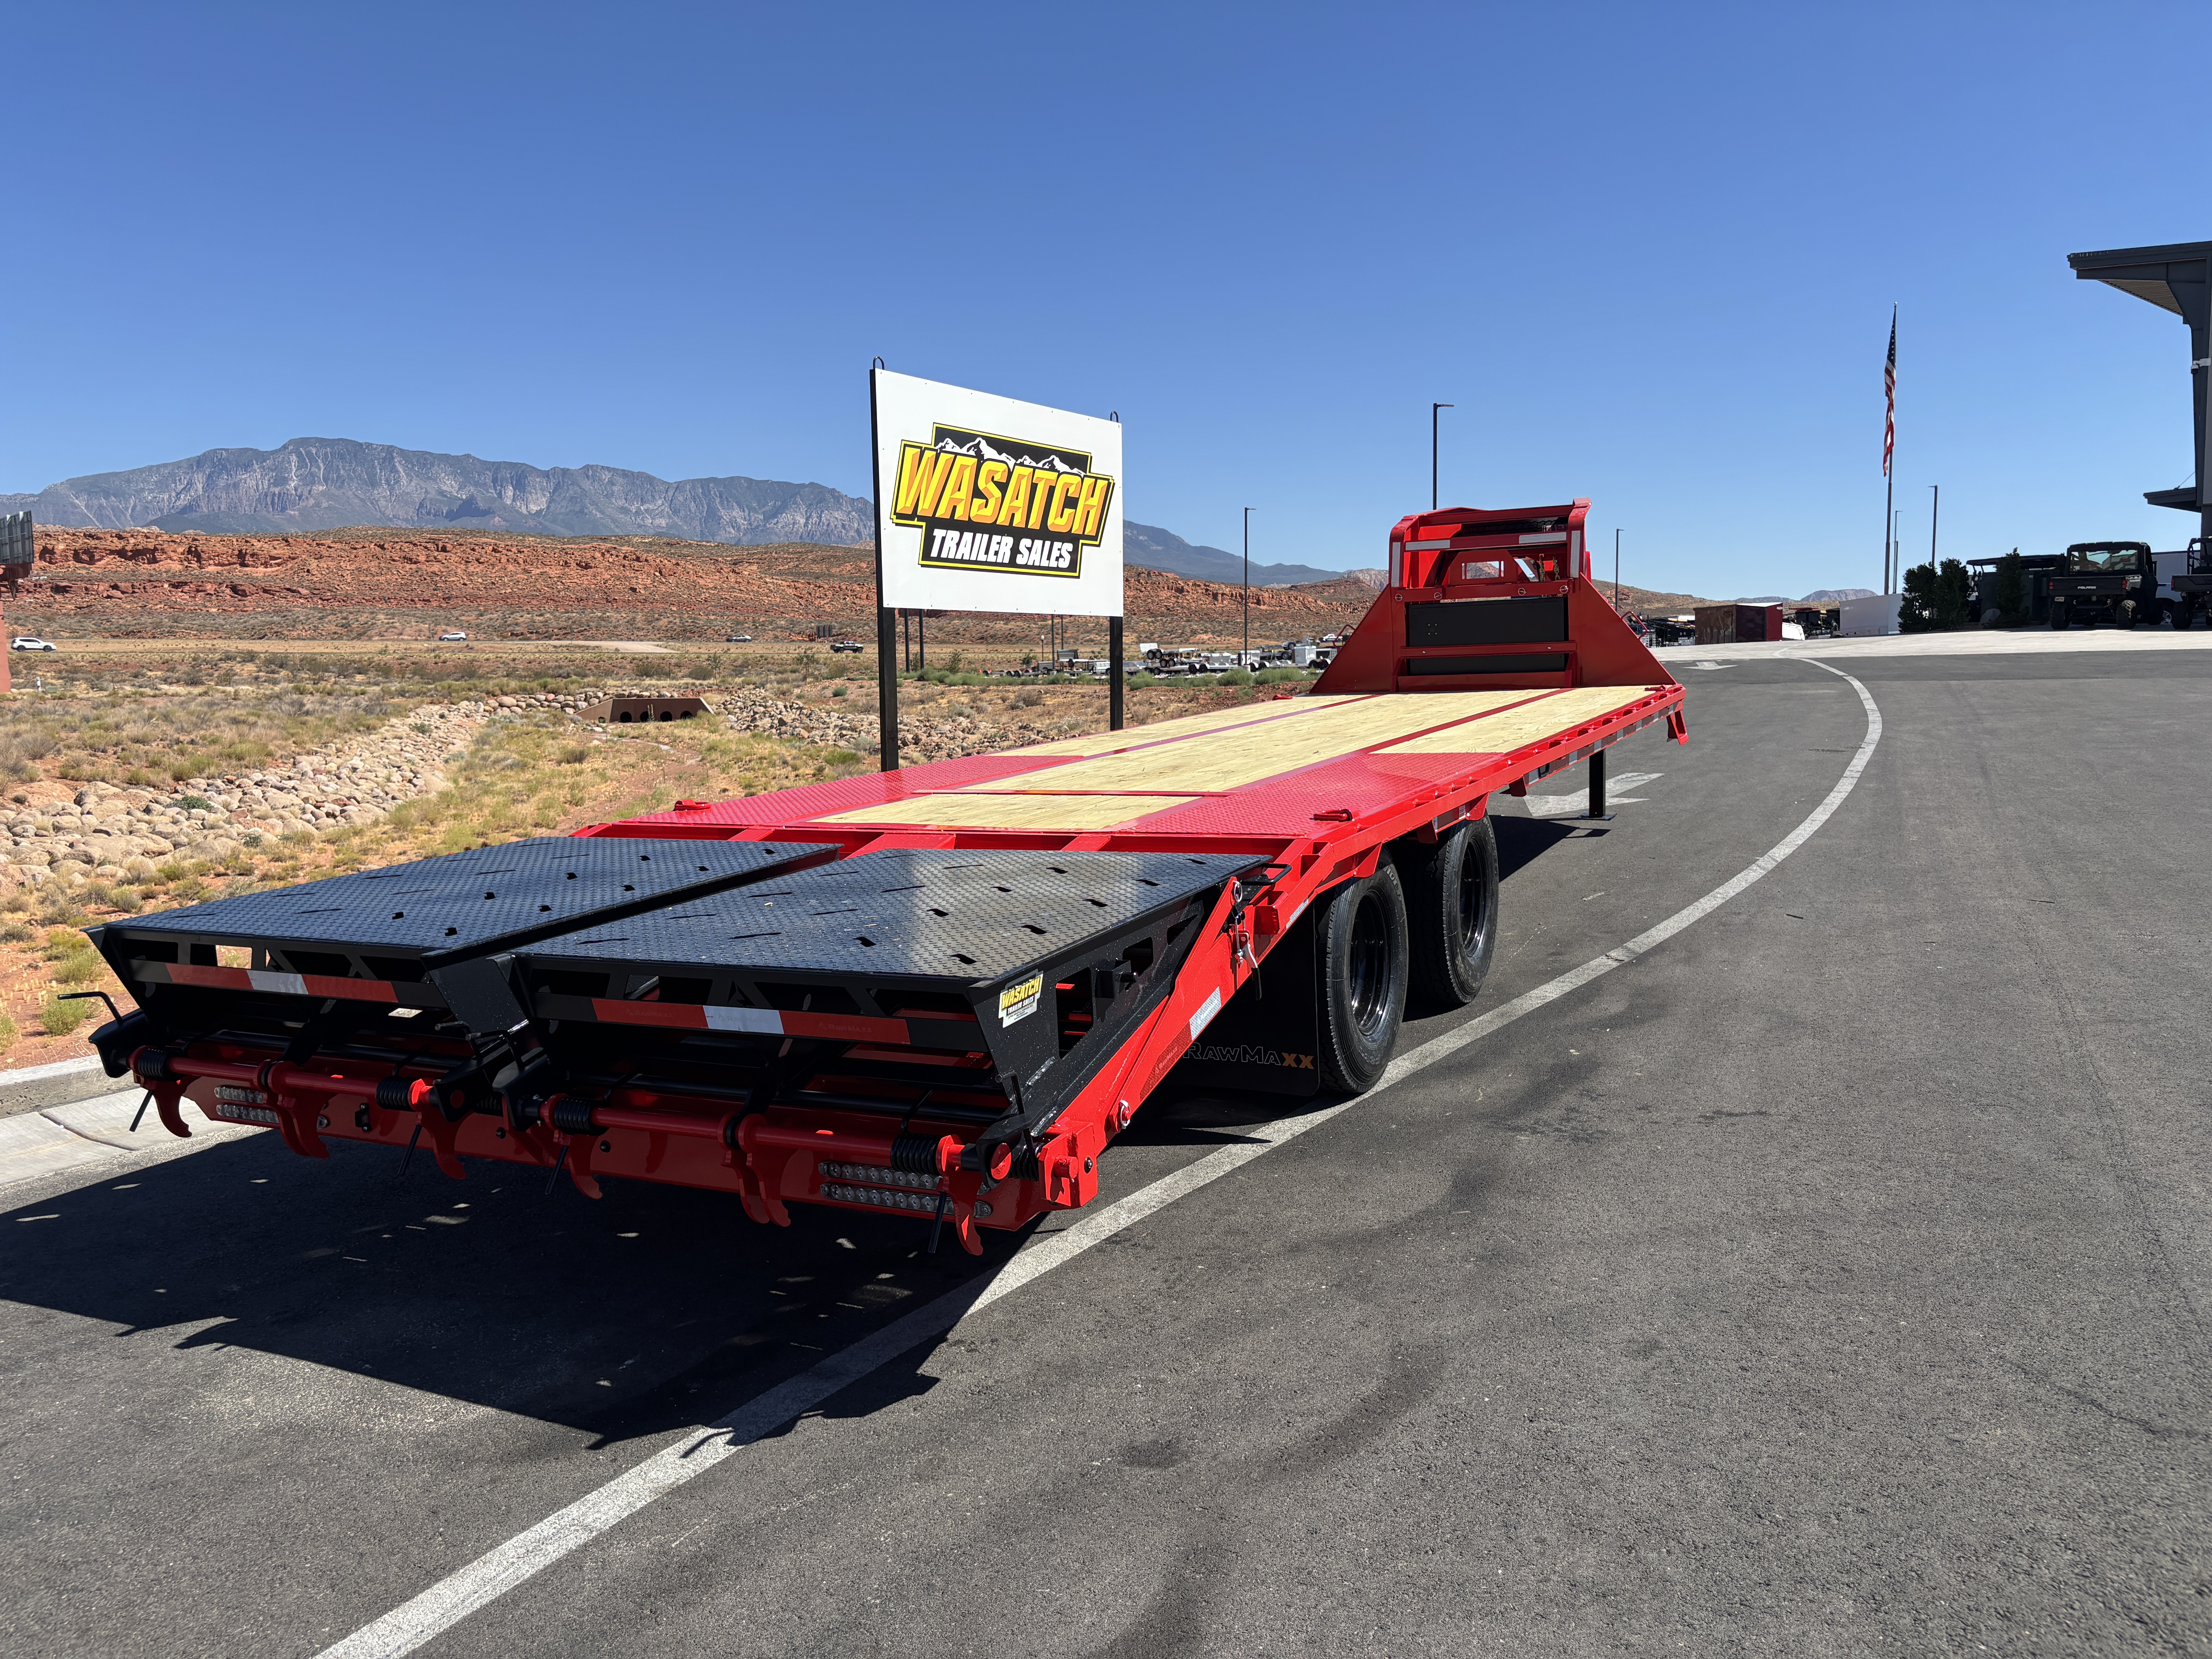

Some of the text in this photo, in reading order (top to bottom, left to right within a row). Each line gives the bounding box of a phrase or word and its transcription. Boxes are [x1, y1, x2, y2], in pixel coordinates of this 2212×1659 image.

[896, 447, 1108, 536] WASATCH
[931, 529, 1073, 568] TRAILER SALES
[1002, 976, 1040, 1010] WASATCH
[1008, 1001, 1022, 1015] TRAILER
[1022, 996, 1034, 1007] SALES
